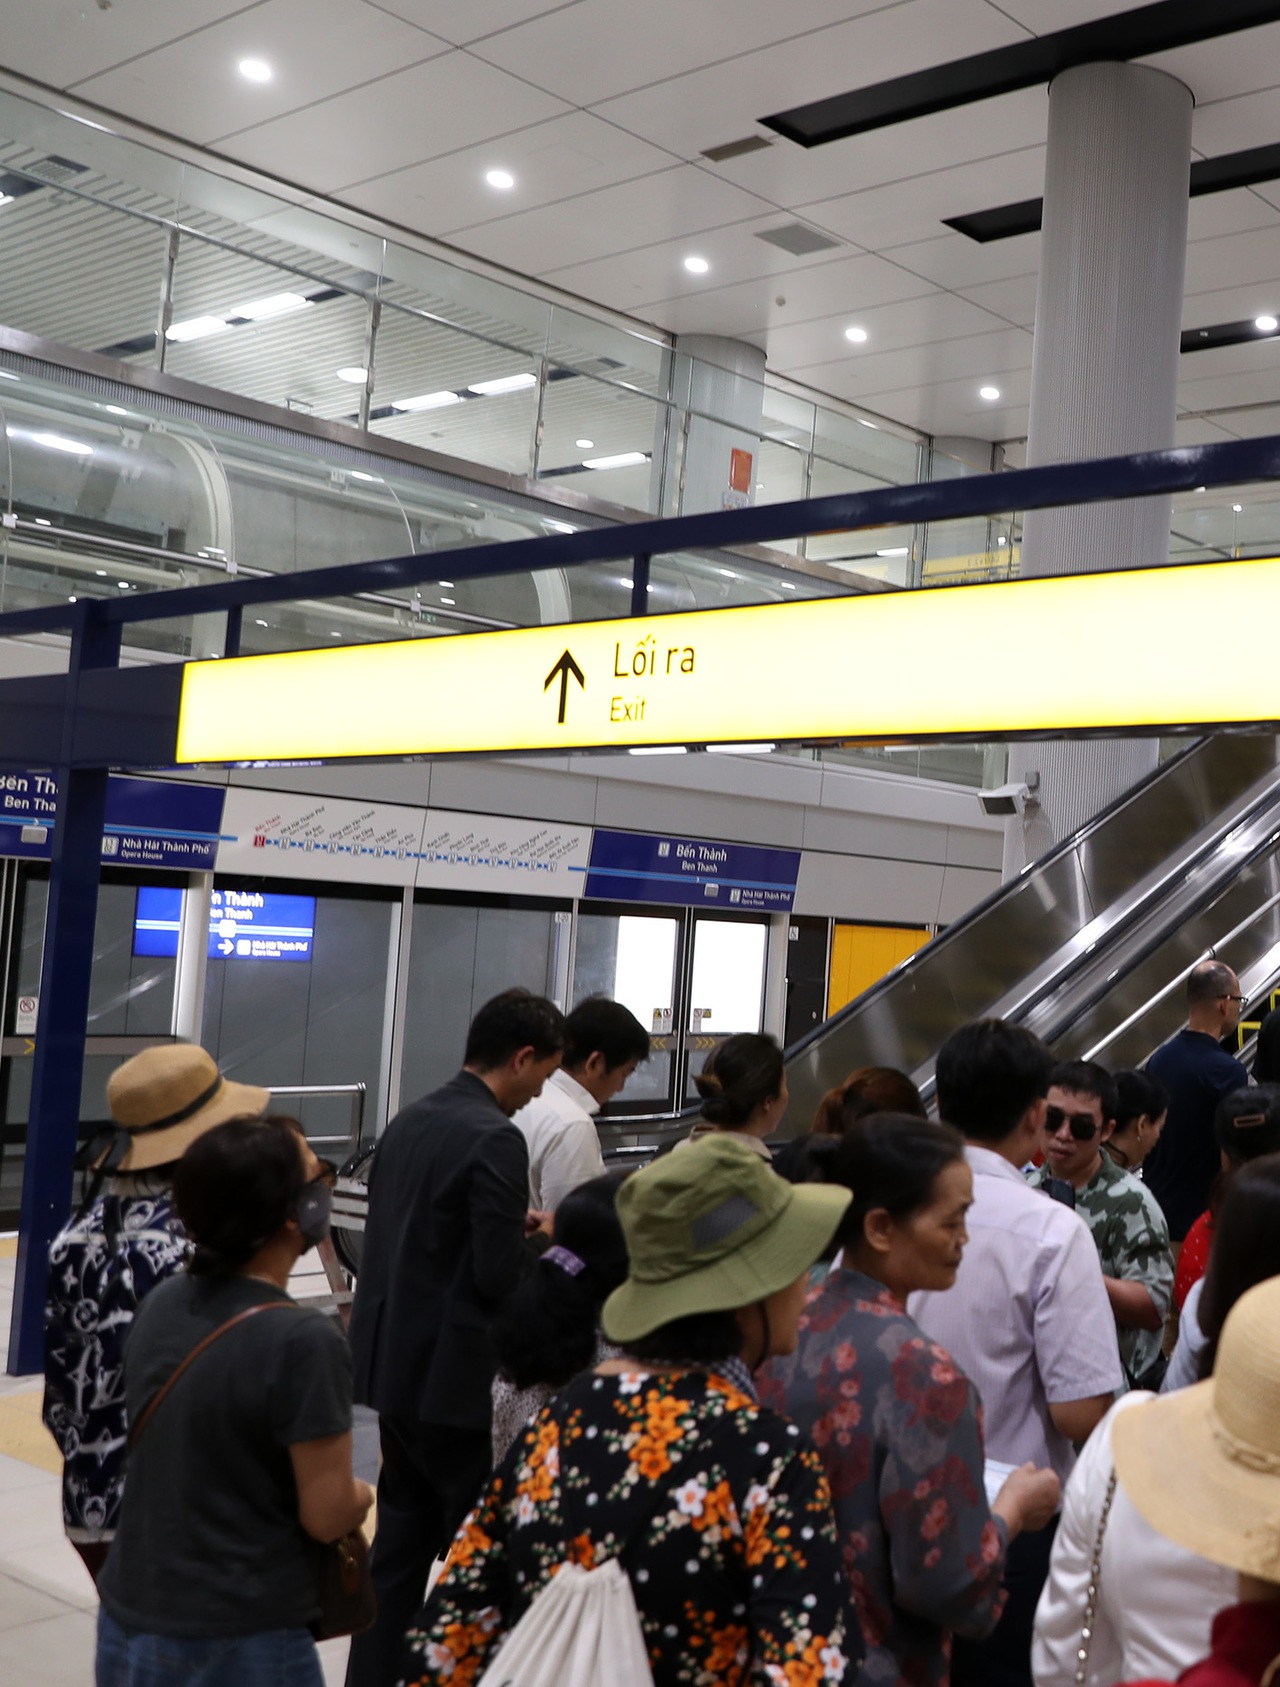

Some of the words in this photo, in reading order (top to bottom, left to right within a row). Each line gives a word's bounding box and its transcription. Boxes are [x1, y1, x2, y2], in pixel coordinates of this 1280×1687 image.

[614, 634, 656, 677] Lối
[666, 646, 695, 674] ra
[610, 696, 646, 722] Exit
[5, 795, 30, 809] Ben
[34, 797, 56, 812] Tha
[122, 838, 141, 849] Nhà
[162, 840, 189, 853] Thành
[676, 843, 696, 859] Bến
[699, 846, 727, 862] Thành
[121, 850, 141, 859] Opera
[682, 860, 696, 871] Ben
[697, 861, 718, 873] Thanh
